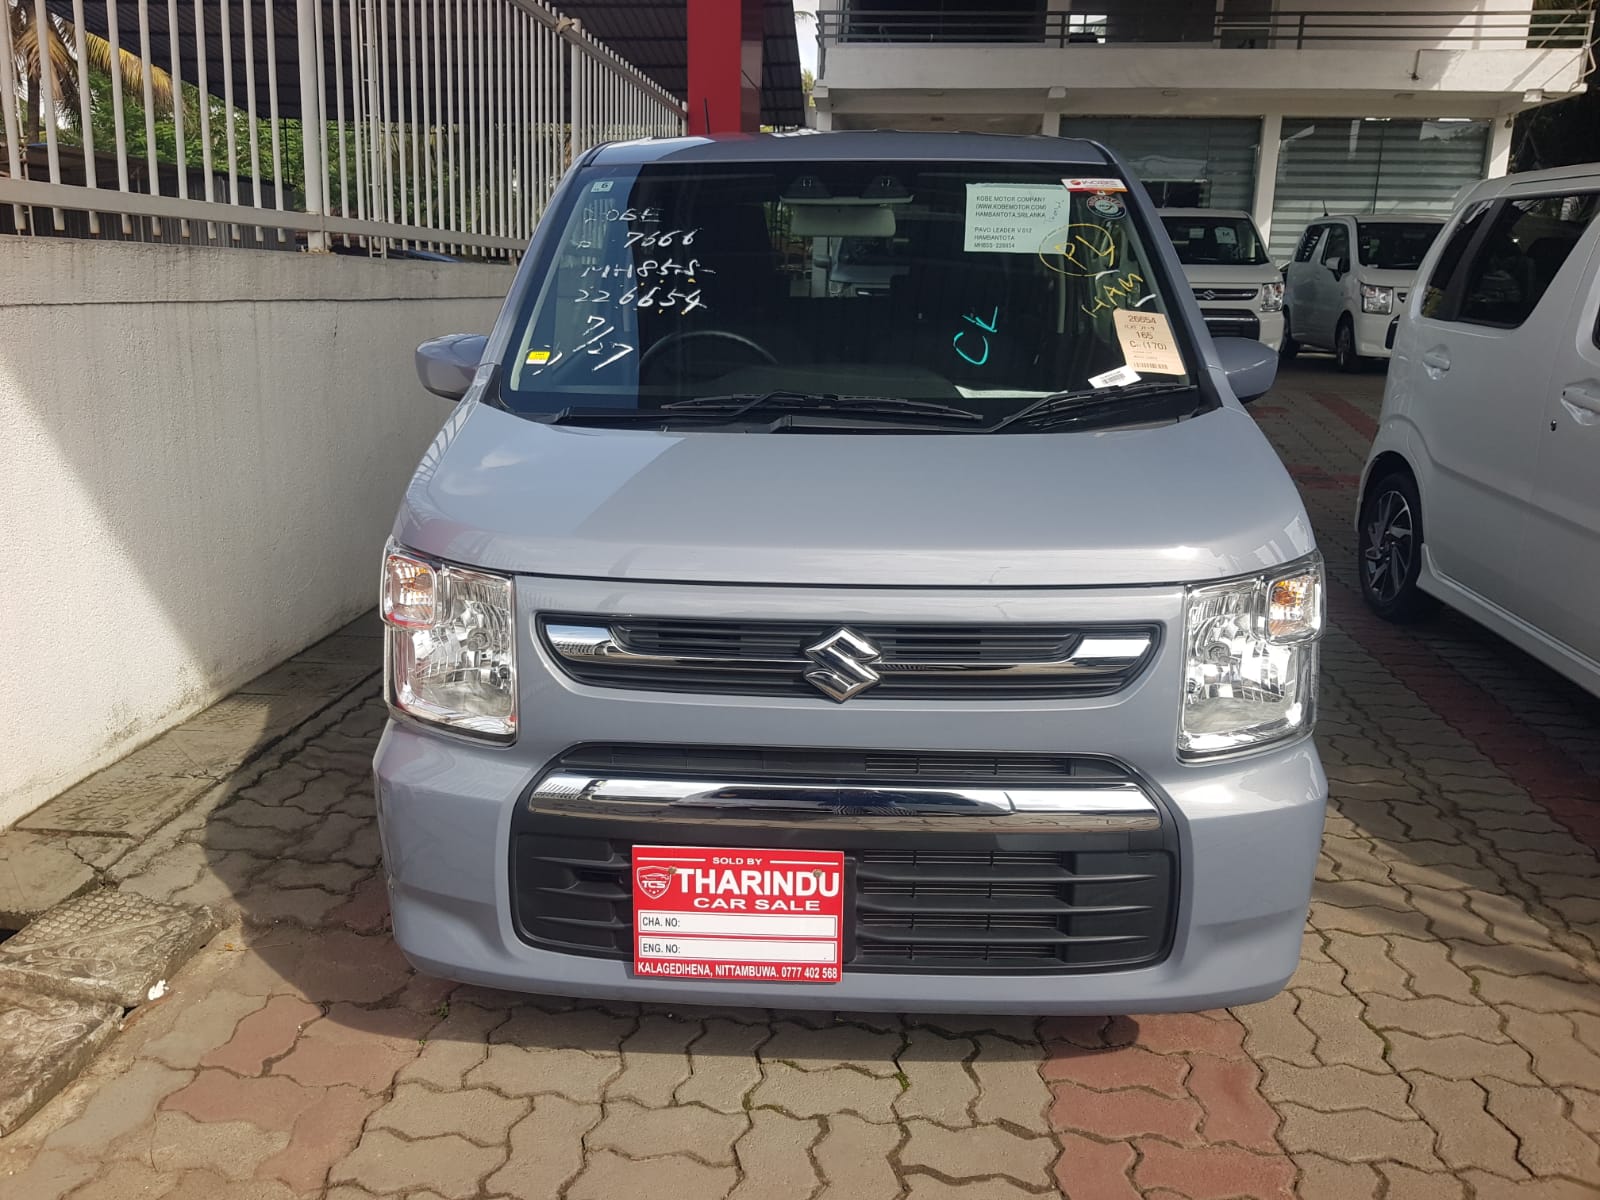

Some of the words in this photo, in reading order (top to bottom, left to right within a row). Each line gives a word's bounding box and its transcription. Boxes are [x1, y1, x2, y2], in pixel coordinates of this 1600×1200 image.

[712, 856, 744, 865] SOLD
[746, 857, 763, 866] BY
[641, 880, 667, 889] TCS
[676, 867, 840, 897] THARINDU
[693, 897, 747, 910] CAR
[754, 899, 821, 912] SALE
[642, 916, 663, 927] CHA.
[665, 917, 681, 928] NO:
[642, 943, 664, 954] ENG.
[665, 944, 681, 954] NO:
[638, 962, 713, 978] KALAGEDIHENA,
[715, 964, 779, 978] NITTAMBUWA.
[781, 966, 802, 979] 0777
[804, 967, 820, 979] 402
[822, 967, 838, 979] 568
